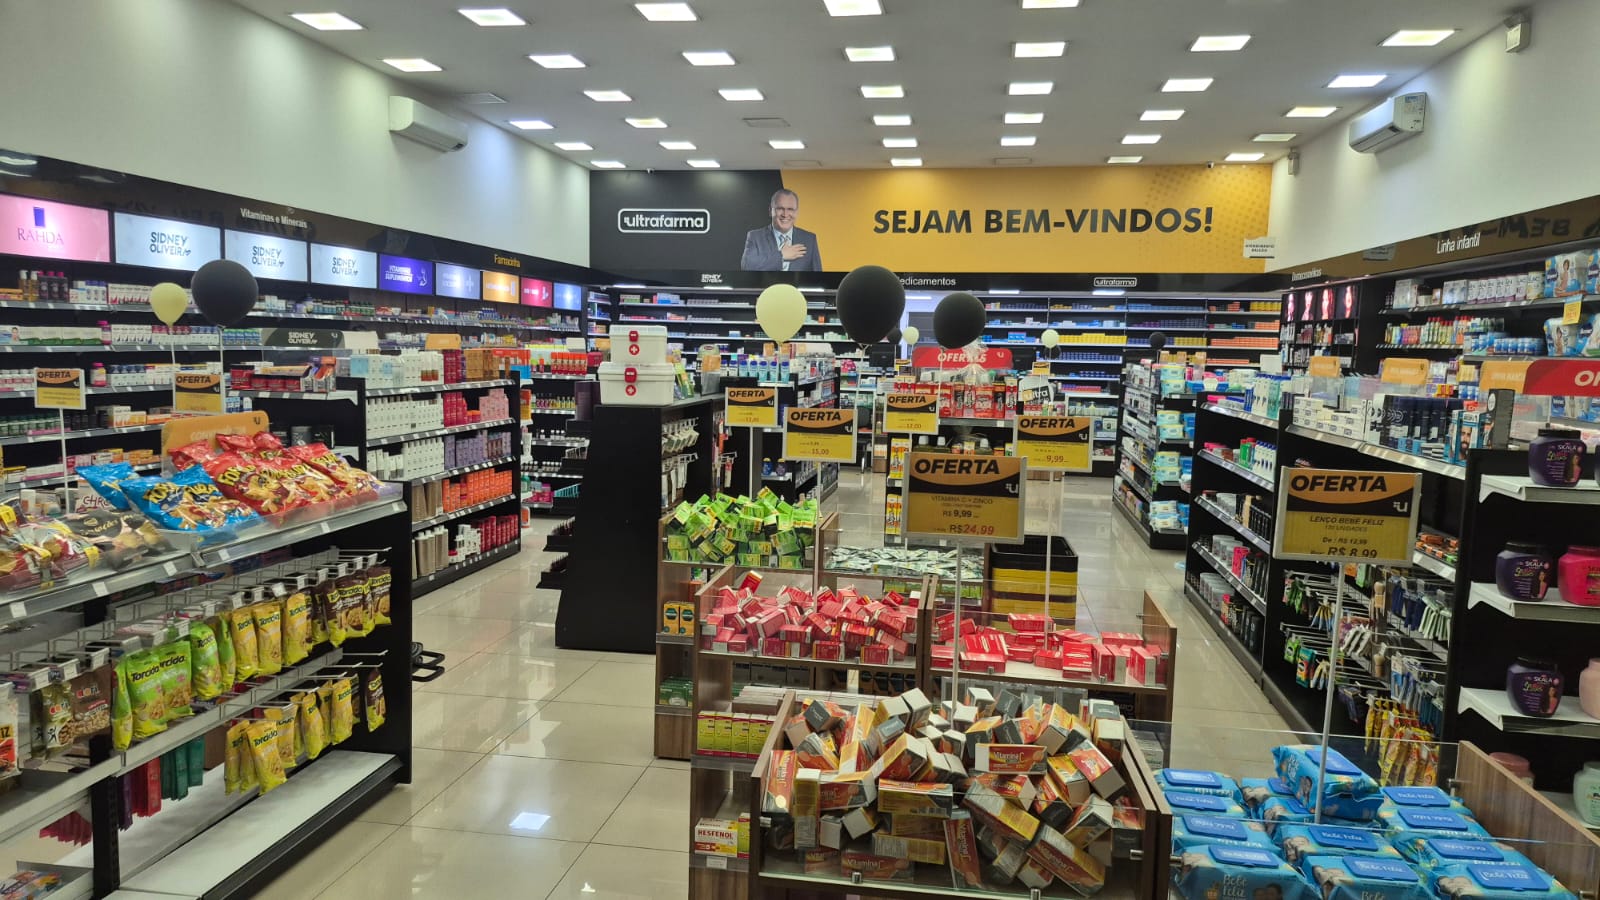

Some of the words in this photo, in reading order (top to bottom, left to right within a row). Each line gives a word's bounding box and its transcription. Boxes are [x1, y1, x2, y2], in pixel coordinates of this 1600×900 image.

[240, 207, 274, 223] Vitaminas
[281, 215, 308, 229] Minerais
[623, 214, 705, 228] ultrafarma
[873, 209, 972, 234] SEJAM
[984, 206, 1214, 234] BEM-VINDOS!
[17, 227, 65, 246] RAHDA
[150, 231, 190, 246] SIDNEY
[1436, 237, 1455, 254] Linha
[1456, 232, 1481, 250] infantil
[252, 245, 283, 259] SIDNEY
[332, 256, 358, 269] SIDNEY
[898, 276, 957, 287] edicamentos
[1095, 278, 1136, 286] ultrafarma
[37, 370, 72, 379] OFERTA
[176, 375, 212, 384] OFERTA
[729, 390, 766, 398] OFERTA
[888, 395, 927, 404] OFERTA
[790, 410, 842, 422] OFERTA
[1020, 417, 1076, 429] OFERTA
[1046, 454, 1065, 463] 9,99
[914, 458, 1000, 475] OFERTA
[1291, 475, 1387, 492] OFERTA
[931, 495, 960, 503] VITAMINA
[953, 509, 972, 518] 9,99
[1310, 515, 1337, 524] LENÇO
[1361, 518, 1385, 526] FELIZ
[1327, 546, 1347, 557] R$
[1349, 547, 1378, 559] 899
[993, 751, 1018, 763] Vitamina
[1018, 751, 1026, 764] C
